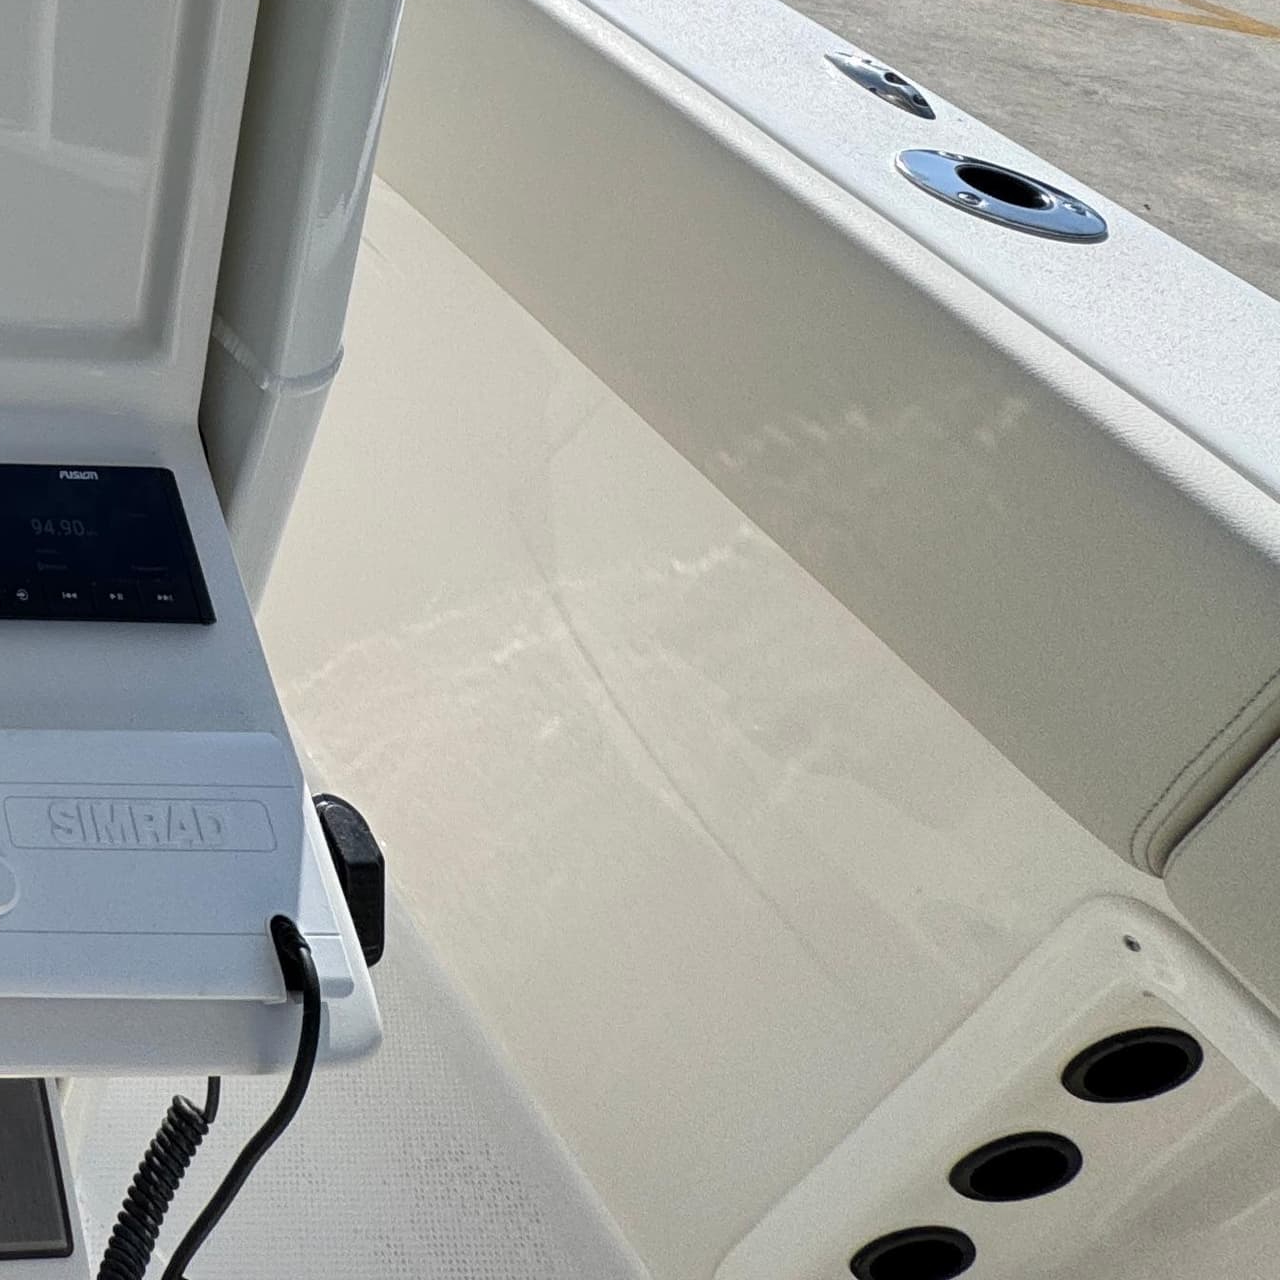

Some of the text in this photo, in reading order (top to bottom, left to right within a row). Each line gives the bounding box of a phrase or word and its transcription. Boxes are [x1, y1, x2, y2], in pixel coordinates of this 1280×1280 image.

[58, 470, 99, 480] FUSION
[30, 517, 86, 537] 94.90
[48, 801, 224, 846] SIMRAD
